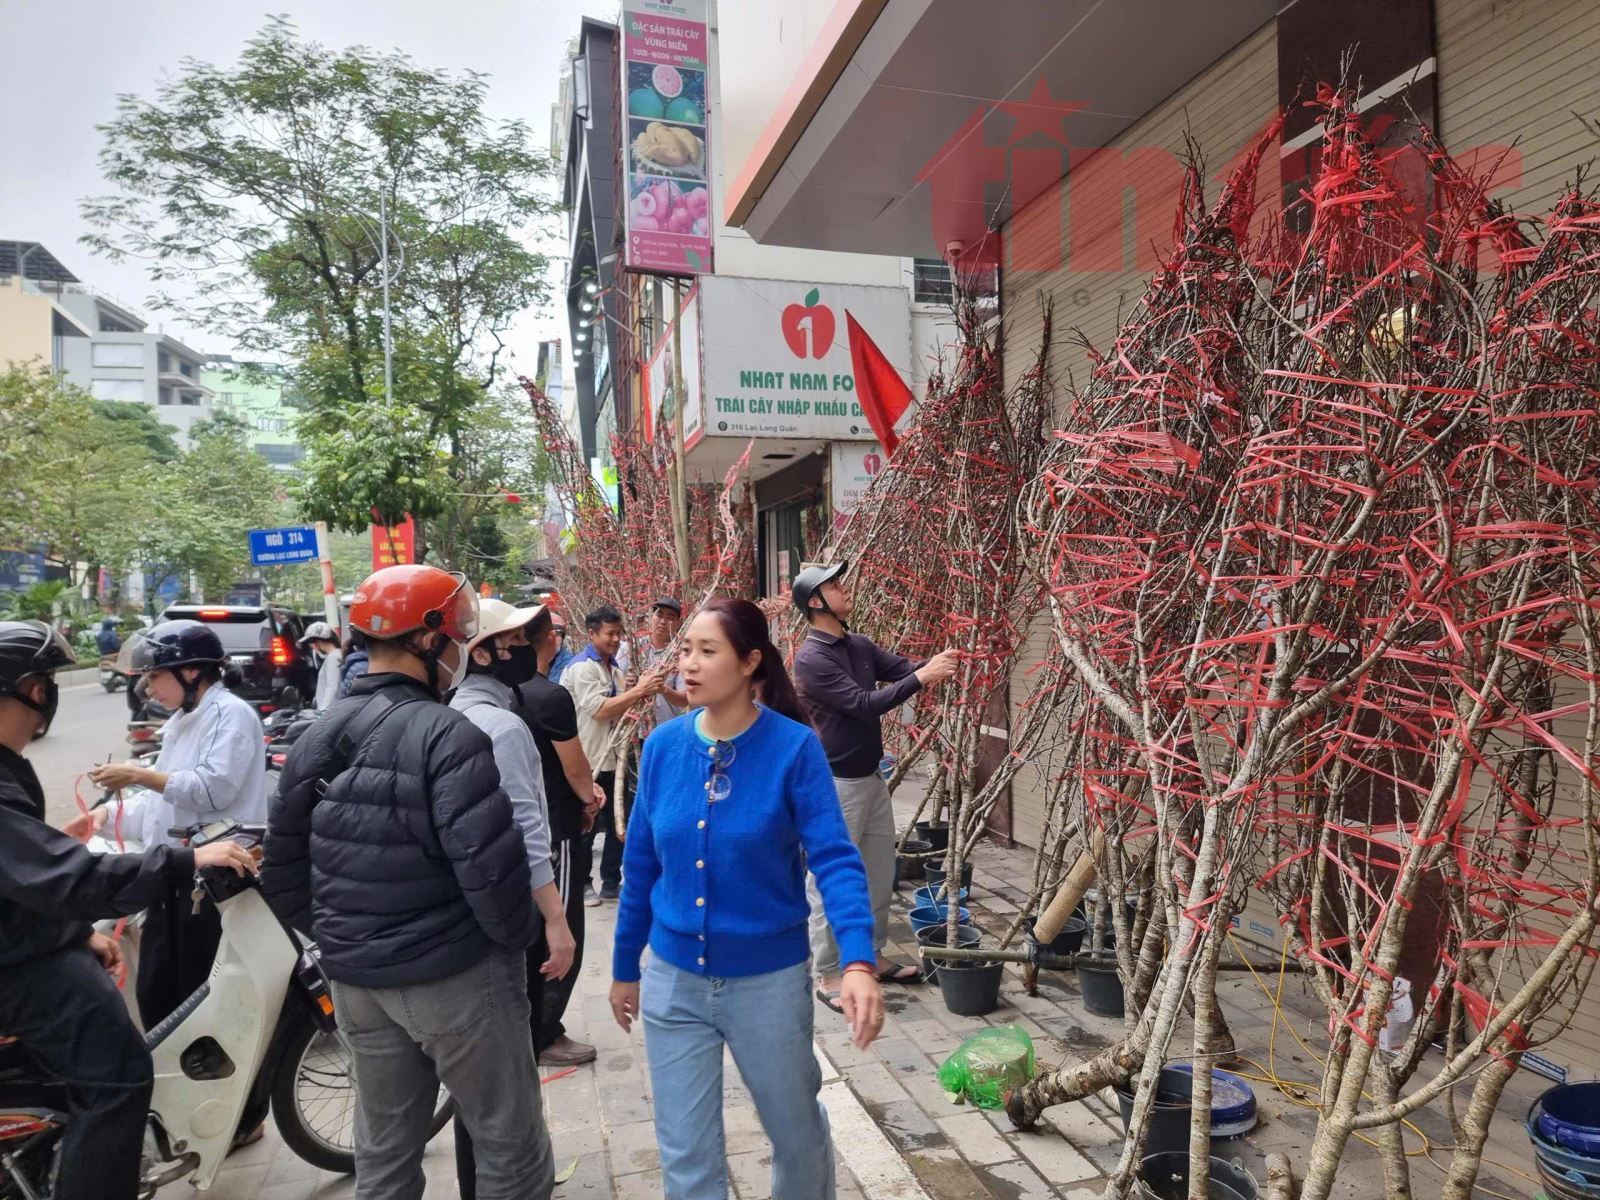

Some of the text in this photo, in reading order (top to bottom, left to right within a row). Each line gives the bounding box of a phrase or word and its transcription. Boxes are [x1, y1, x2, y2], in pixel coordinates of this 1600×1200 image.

[666, 26, 683, 37] TRÁI
[684, 29, 699, 39] CÂY
[645, 35, 667, 48] VÙNG
[740, 370, 854, 392] NHAT NAM FO
[715, 396, 745, 413] TRÁI
[749, 397, 774, 414] CÂY
[777, 398, 811, 418] NHẬP
[814, 396, 847, 416] KHẨU
[760, 424, 778, 433] Long
[288, 532, 304, 545] 314
